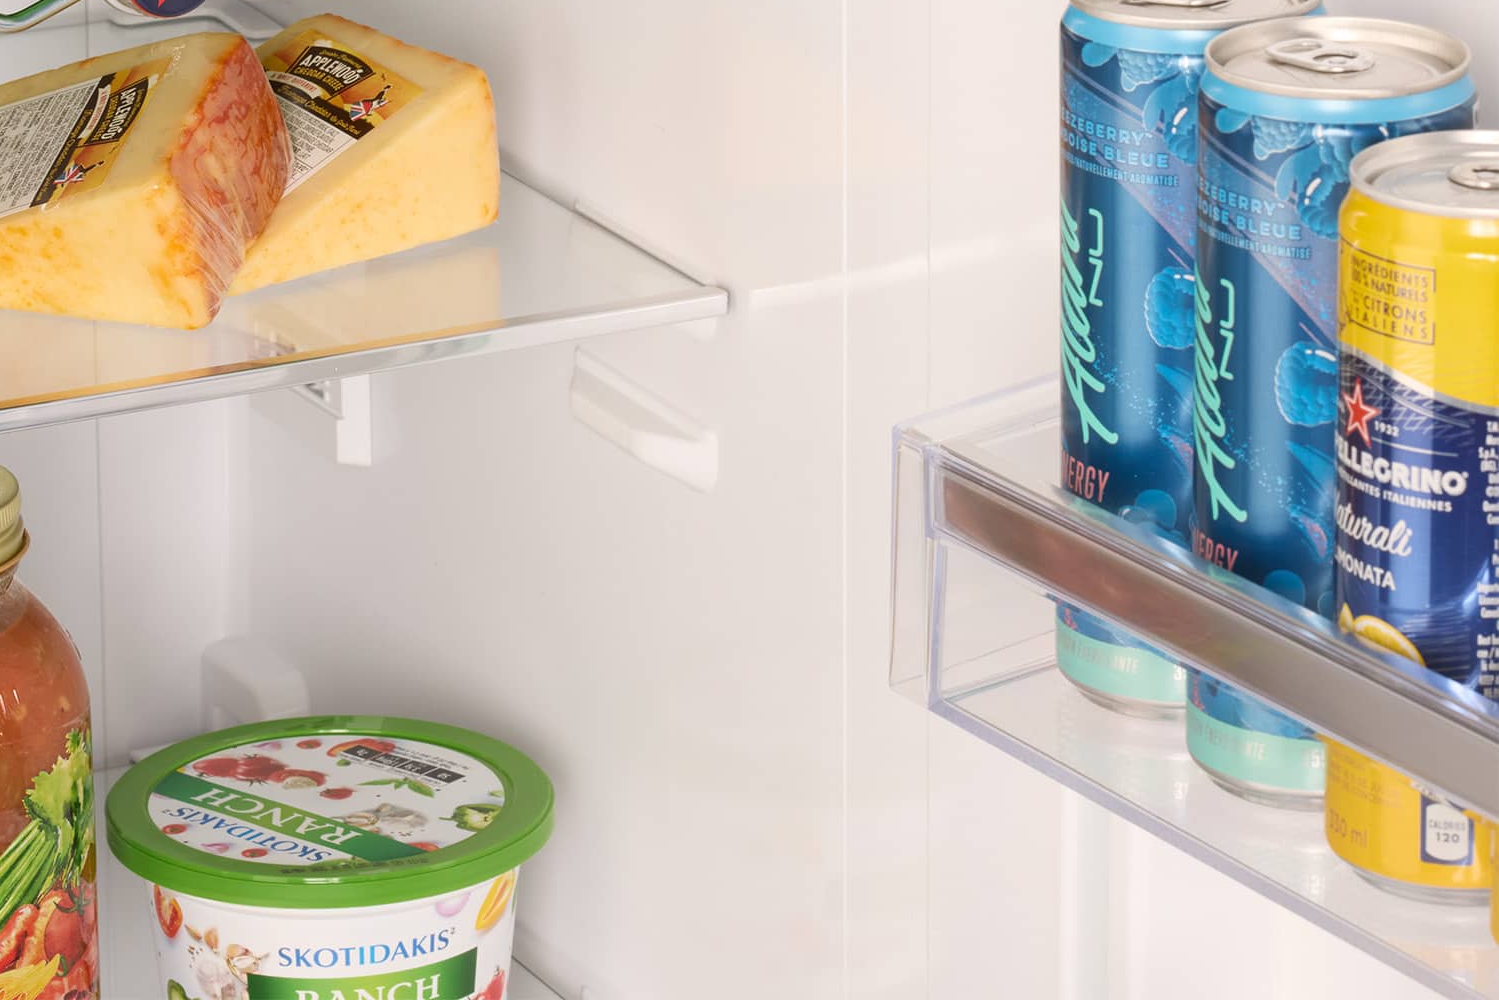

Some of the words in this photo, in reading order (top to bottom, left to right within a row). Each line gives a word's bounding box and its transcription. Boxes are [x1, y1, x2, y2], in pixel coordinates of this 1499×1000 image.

[299, 54, 363, 84] APPLEWOOD
[1104, 146, 1170, 169] BLEUE
[1236, 220, 1302, 241] BLEUE
[1371, 278, 1427, 303] NATURELS
[1363, 295, 1427, 324] CITRONS
[1383, 490, 1452, 513] ITALIENNES
[1336, 503, 1413, 557] aturali
[192, 788, 363, 845] RANCH
[171, 807, 332, 862] SKOTIDAKIS
[1435, 832, 1460, 845] 120
[277, 929, 450, 970] SKOTIDAKIS
